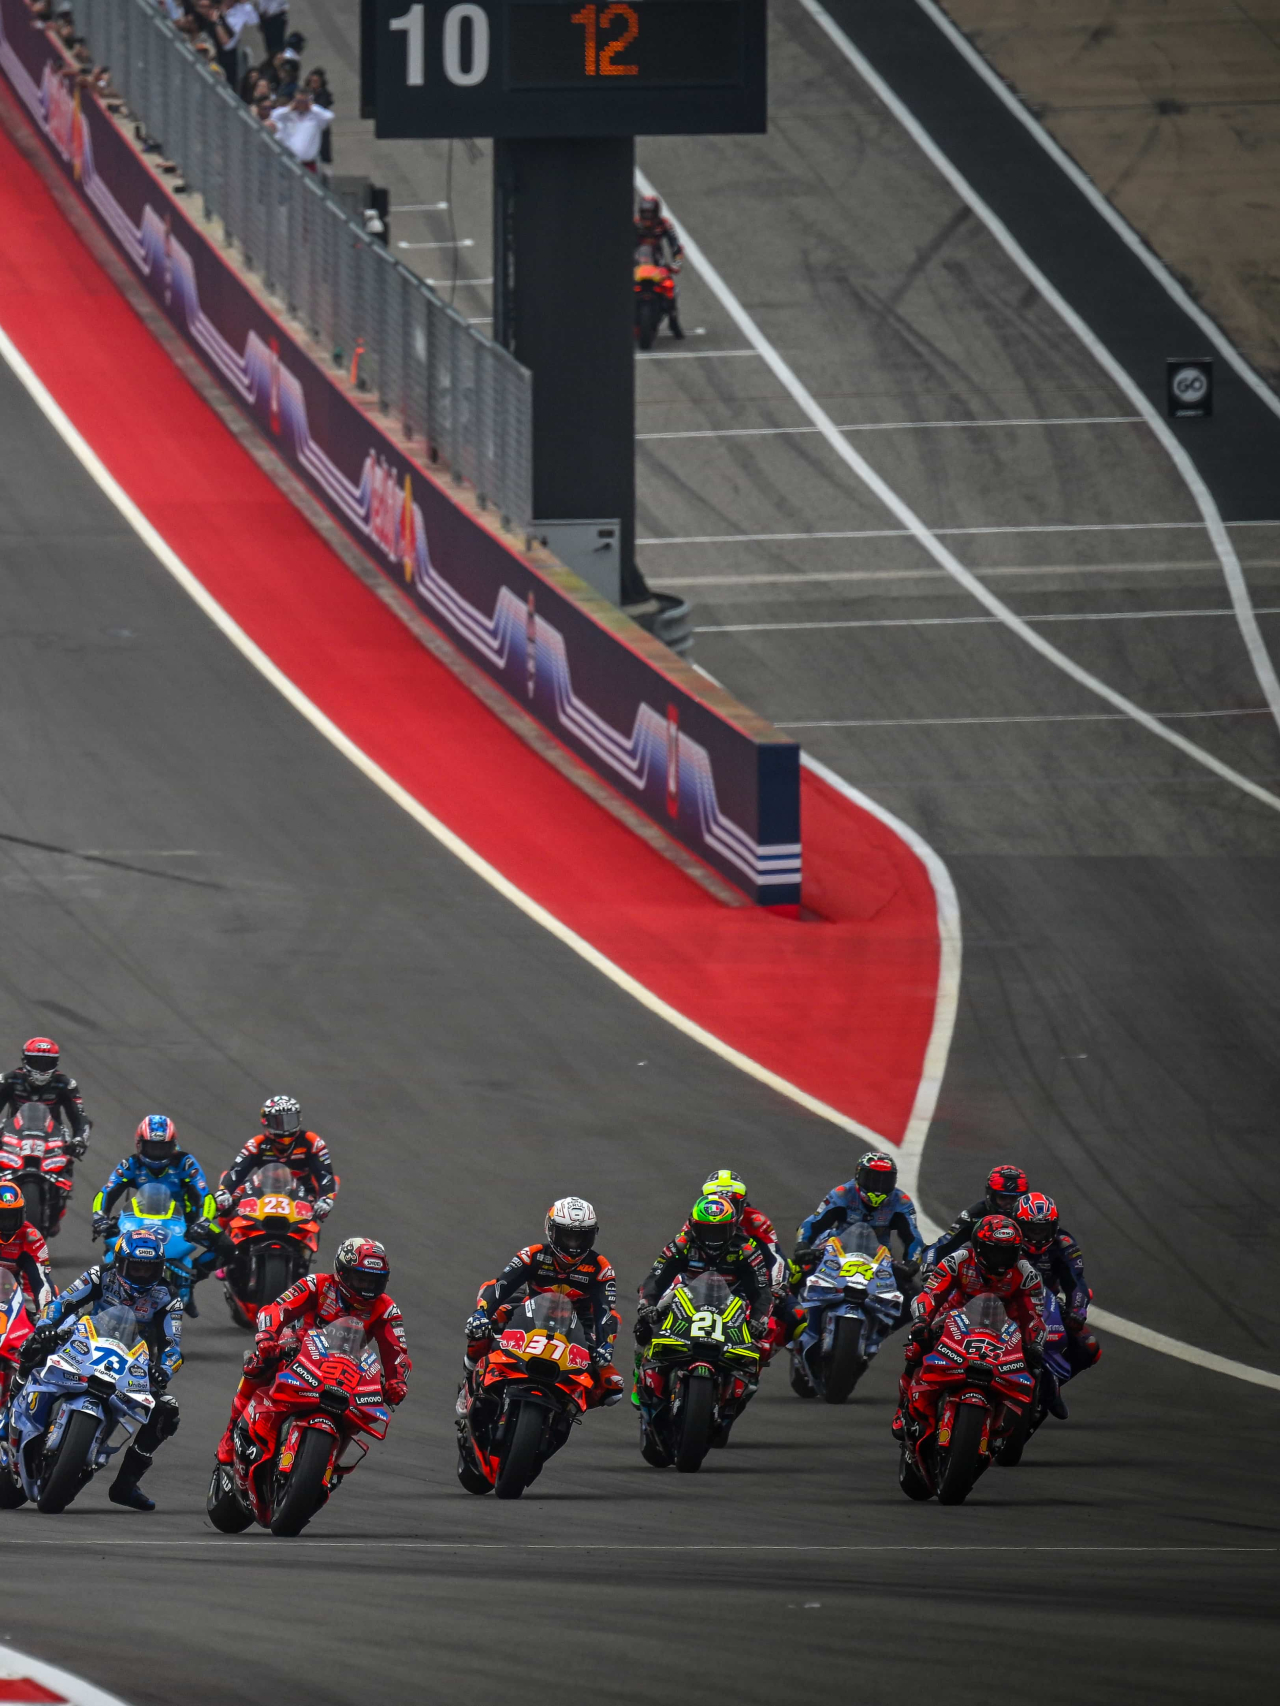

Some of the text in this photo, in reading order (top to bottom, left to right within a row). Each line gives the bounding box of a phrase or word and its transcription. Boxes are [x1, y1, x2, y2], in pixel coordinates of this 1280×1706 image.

[389, 3, 490, 86] 10
[571, 3, 639, 76] 12
[263, 1197, 291, 1214] 23
[838, 1260, 875, 1281] 54
[690, 1311, 725, 1343] 21
[87, 1345, 129, 1376] 73
[523, 1335, 568, 1361] 37
[937, 1344, 964, 1364] Lenovo
[961, 1337, 1006, 1364] 63
[292, 1362, 319, 1387] Lenovo
[320, 1360, 362, 1390] 93
[998, 1361, 1025, 1373] Lenovo
[355, 1395, 382, 1405] Lenovo
